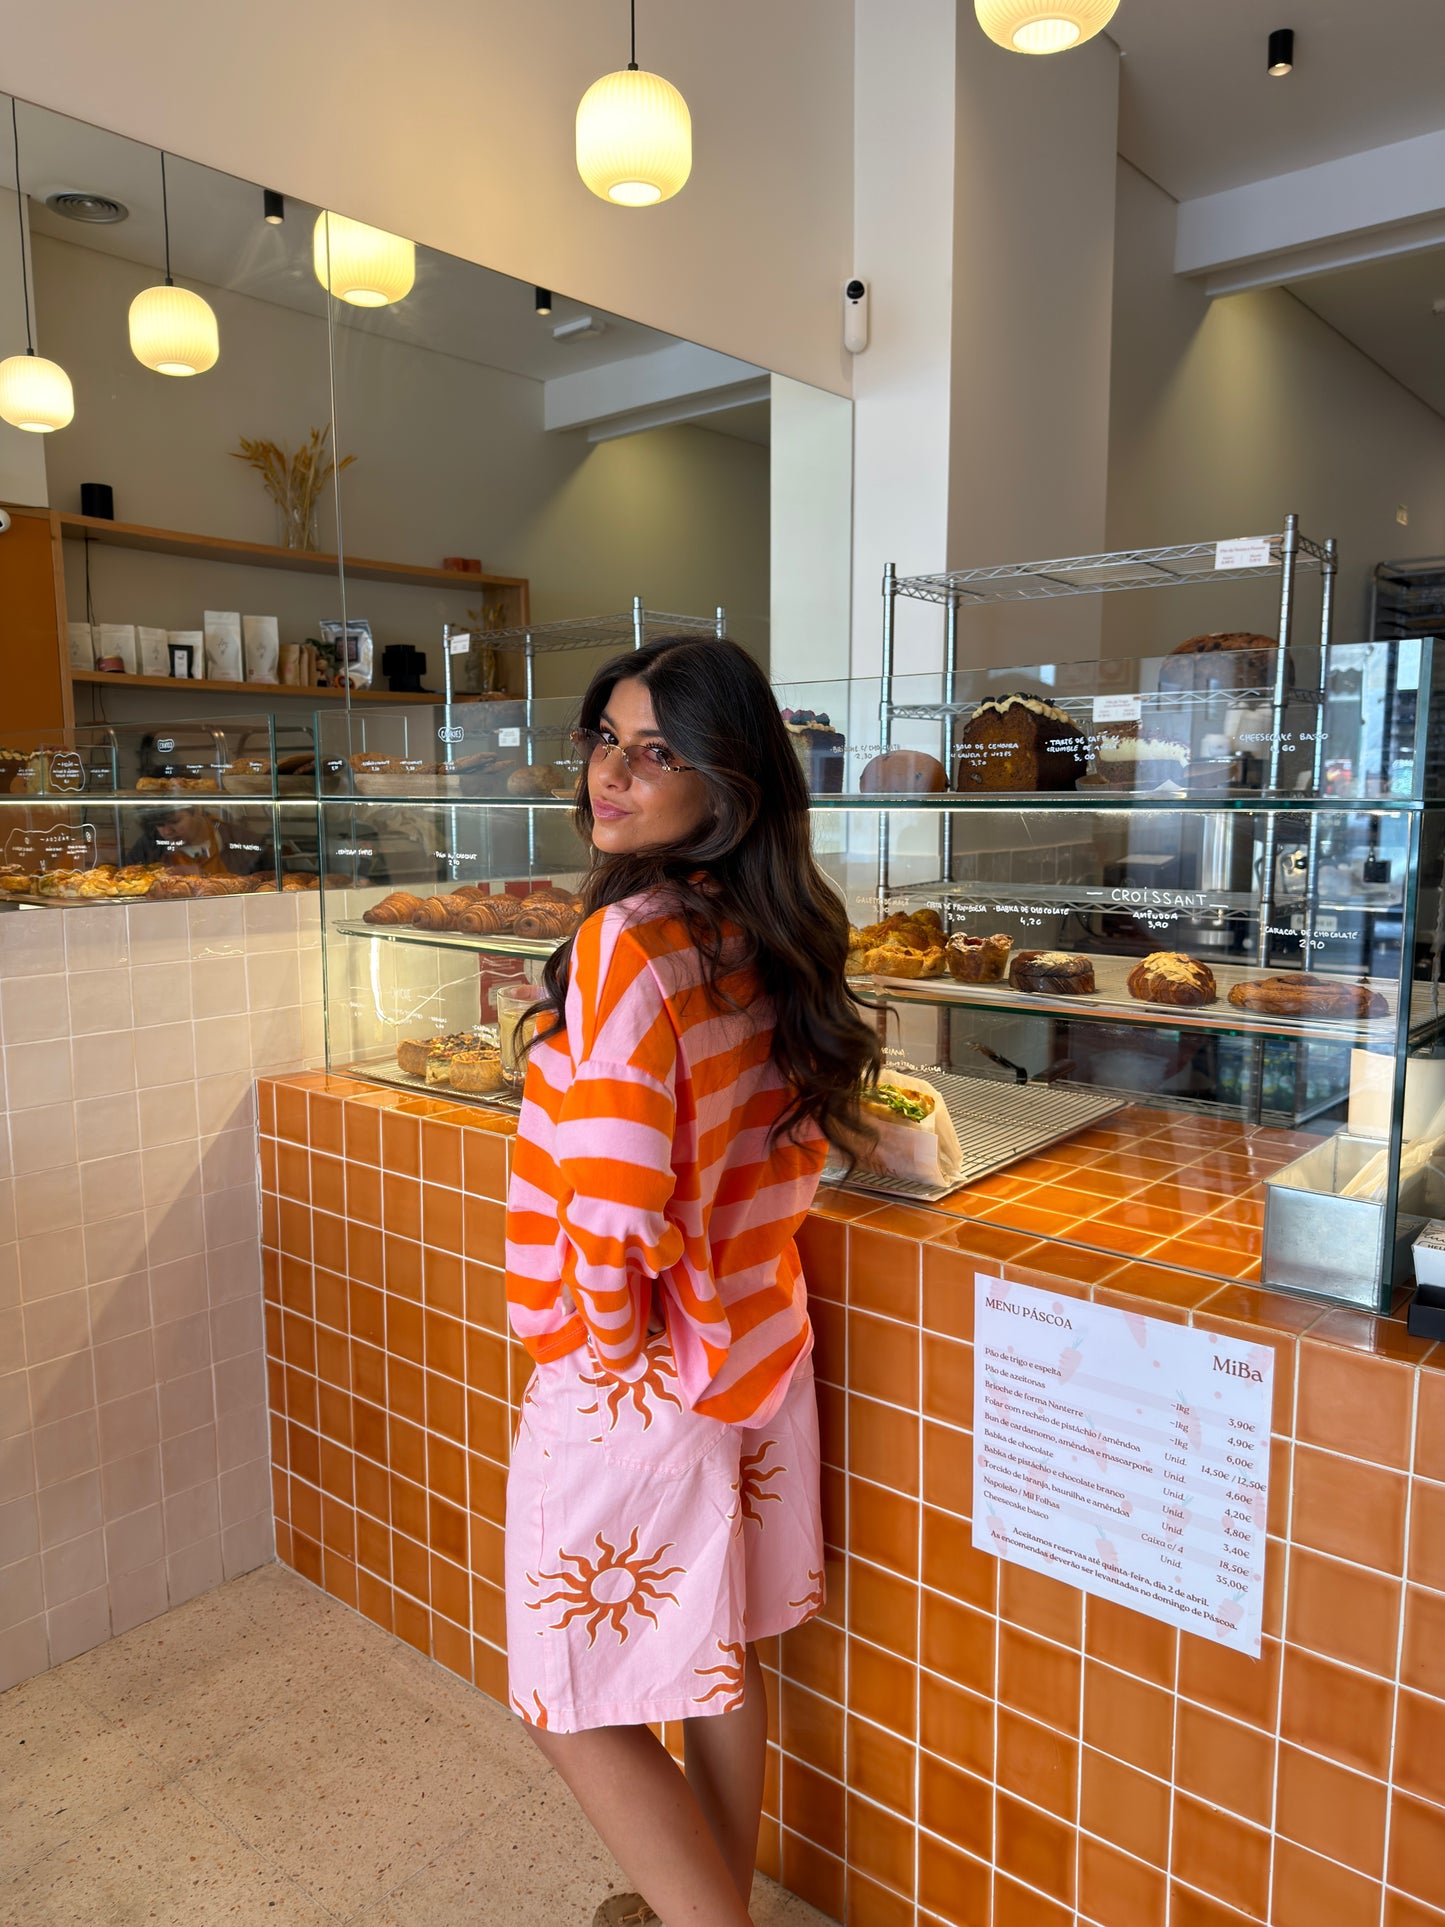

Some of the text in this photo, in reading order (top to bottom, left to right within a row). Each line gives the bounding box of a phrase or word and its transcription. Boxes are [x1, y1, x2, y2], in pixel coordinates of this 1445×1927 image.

[955, 743, 972, 751] BOLO
[1046, 745, 1078, 753] CRUMBLE
[1049, 738, 1073, 746] TARTE
[1074, 736, 1085, 745] DE
[1073, 753, 1096, 762] 5,00
[947, 913, 966, 922] 3,20
[995, 905, 1070, 915] BABKA DE CHOCOLATE
[1020, 916, 1042, 926] 4,20
[1111, 887, 1207, 906] CROISSANT
[1265, 926, 1358, 940] CARACOL DE CHOCOLATE
[986, 1297, 1072, 1330] MENU PÁSCOA
[985, 1348, 1000, 1358] Pão
[1000, 1353, 1009, 1361] de
[1010, 1356, 1028, 1367] trigo
[1034, 1364, 1062, 1377] espelta
[1228, 1419, 1256, 1433] 3,90€
[985, 1364, 999, 1374] Pão
[1000, 1369, 1009, 1378] de
[1010, 1374, 1046, 1389] azeitonas
[1228, 1438, 1255, 1451] 4,90€
[1213, 1356, 1263, 1383] MiBa
[985, 1380, 1013, 1395] Brioche
[1014, 1390, 1023, 1399] de
[1024, 1393, 1047, 1406] forma
[1048, 1400, 1083, 1417] Nanterre
[1227, 1456, 1254, 1469] 6,00€
[985, 1396, 1004, 1408] Folar
[1004, 1404, 1021, 1414] com
[1022, 1410, 1050, 1423] recheio
[1051, 1418, 1061, 1427] de
[1061, 1423, 1097, 1438] pistáchio
[1102, 1436, 1141, 1452] amêndoa
[1165, 1453, 1187, 1466] Unid.
[1202, 1466, 1230, 1480] 14,50€
[1238, 1477, 1267, 1492] 12,50€
[985, 1412, 1000, 1423] Bun
[1000, 1418, 1010, 1427] de
[1010, 1423, 1058, 1443] cardamomo,
[1058, 1439, 1095, 1455] amêndoa
[1102, 1453, 1153, 1473] mascarpone
[1164, 1470, 1186, 1484] Unid.
[1226, 1491, 1253, 1505] 4,60€
[984, 1444, 1007, 1458] Babka
[1007, 1453, 1017, 1462] de
[1018, 1458, 1052, 1474] pistáchio
[1058, 1472, 1095, 1489] chocolate
[1096, 1484, 1125, 1499] branco
[1163, 1505, 1185, 1519] Unid.
[1224, 1528, 1251, 1542] 4,80€
[984, 1460, 1012, 1476] Torcido
[1012, 1471, 1022, 1480] de
[1023, 1474, 1051, 1491] laranja,
[1052, 1484, 1086, 1502] baunilha
[1092, 1501, 1130, 1518] amêndoa
[1162, 1522, 1183, 1536] Unid.
[1224, 1544, 1250, 1559] 3,40€
[985, 1428, 1252, 1523] Babka de chocolate Unid. 4,20€
[984, 1476, 1018, 1494] Napoleão
[1023, 1490, 1035, 1500] Mil
[1035, 1494, 1060, 1509] Folhas
[1141, 1534, 1166, 1548] Caixa
[1220, 1561, 1249, 1577] 18,50€
[984, 1491, 1248, 1593] Cheesecake basco Unid. 35,00€
[991, 1530, 1237, 1630] As encomendas deverão ser levantadas no domingo de Páscoa.
[1013, 1528, 1053, 1547] Aceitamos
[1053, 1544, 1087, 1560] reservas
[1088, 1557, 1101, 1566] até
[1153, 1581, 1167, 1591] dia
[1168, 1585, 1174, 1594] 2
[1174, 1589, 1186, 1598] de
[1186, 1594, 1209, 1607] abril.
